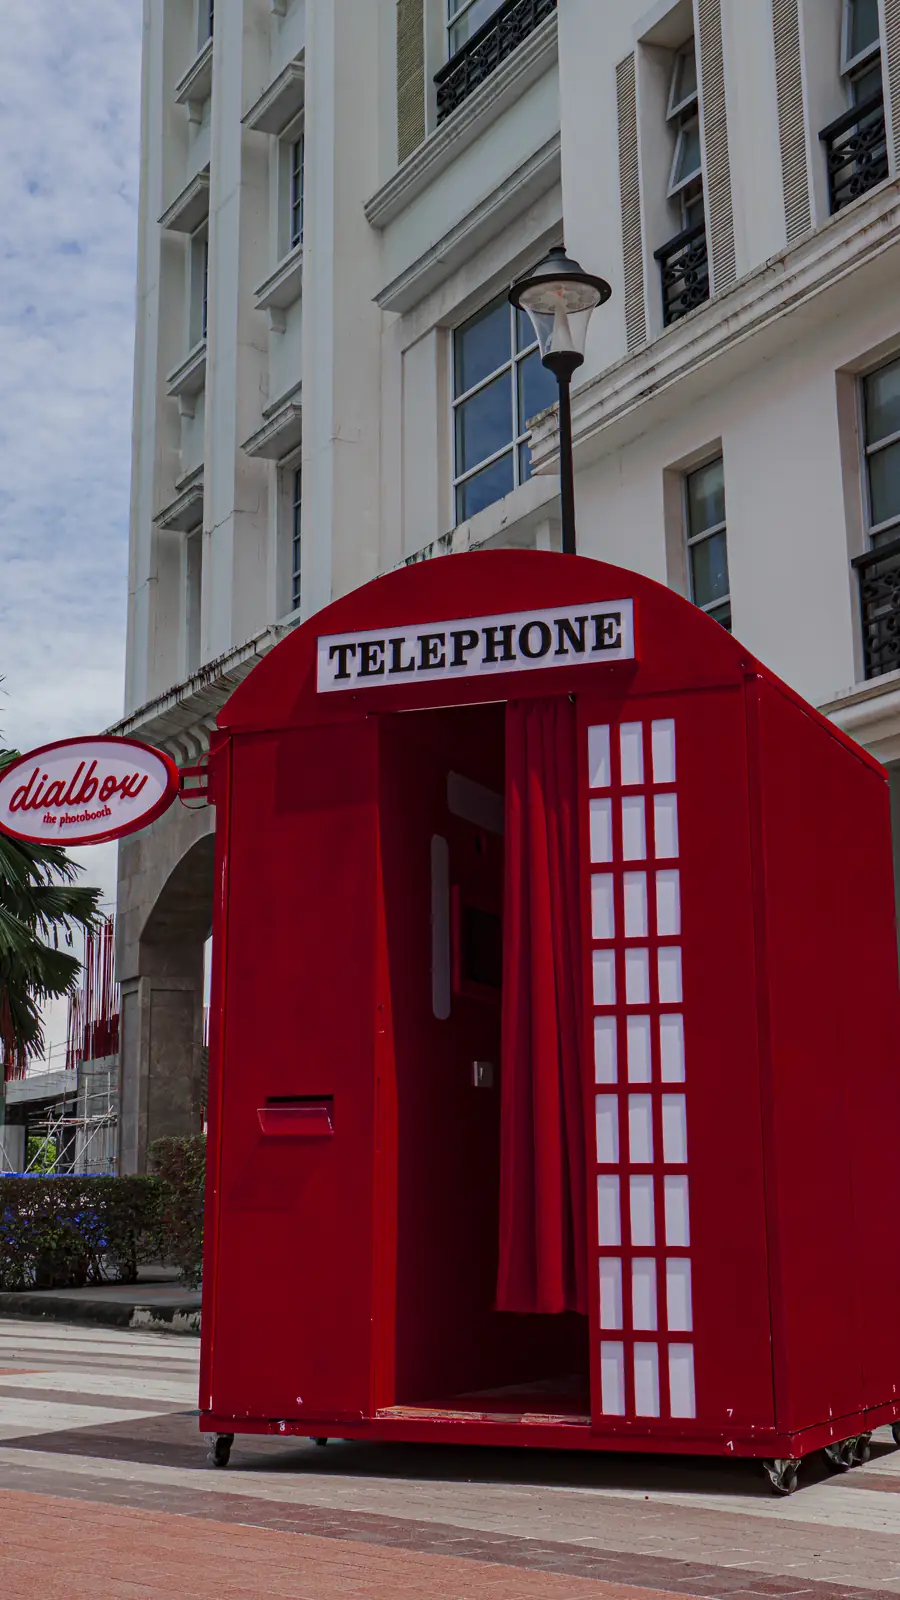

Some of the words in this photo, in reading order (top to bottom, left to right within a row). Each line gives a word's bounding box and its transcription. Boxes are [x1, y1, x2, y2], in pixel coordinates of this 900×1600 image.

[329, 611, 622, 680] TELEPHONE
[8, 759, 149, 813] dialbox
[42, 812, 57, 824] the
[59, 804, 112, 828] photobooth
